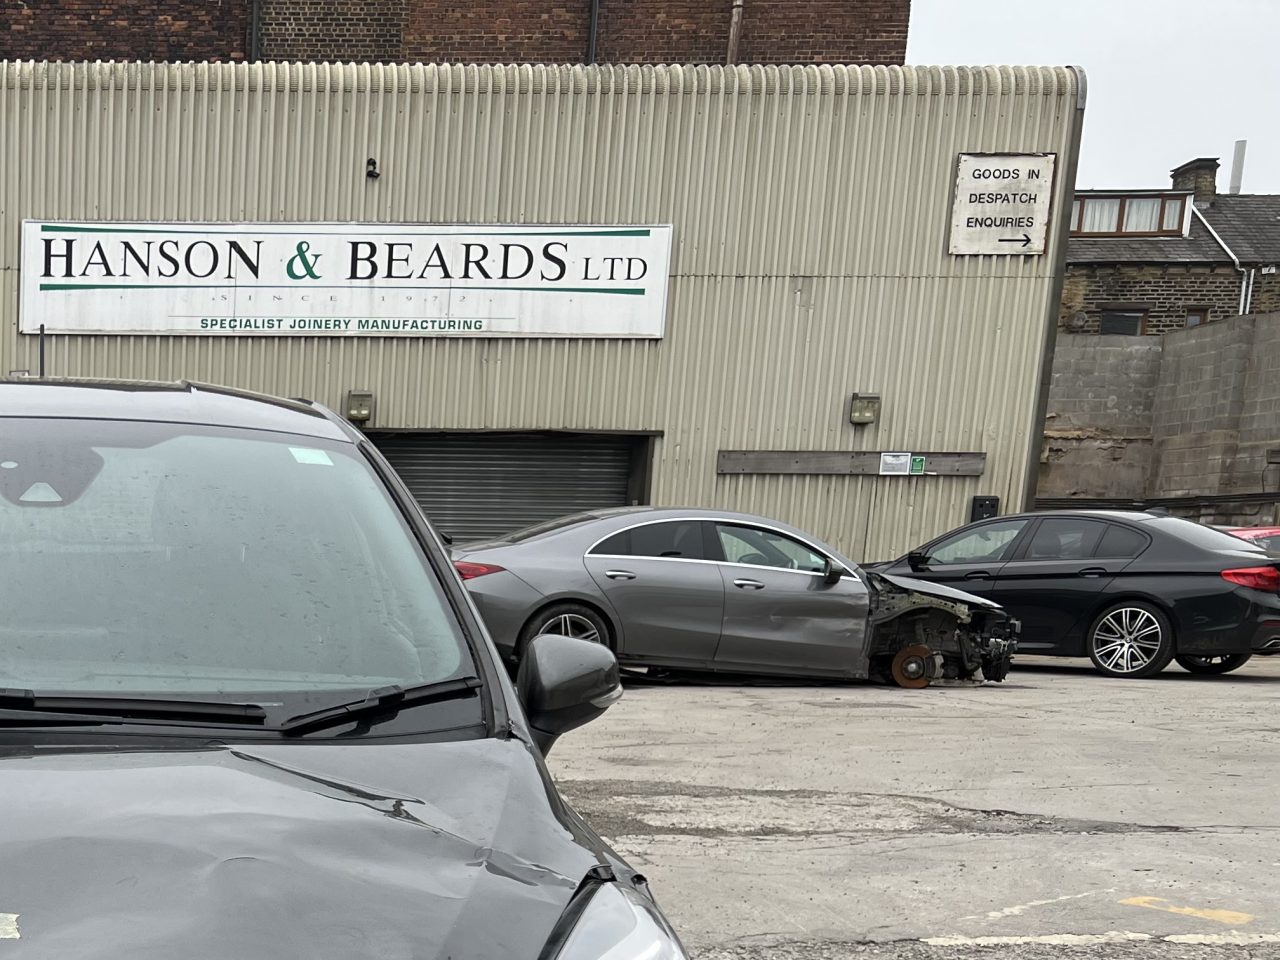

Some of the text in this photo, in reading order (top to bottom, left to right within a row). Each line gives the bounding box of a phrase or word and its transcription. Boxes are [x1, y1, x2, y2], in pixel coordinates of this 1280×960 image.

[972, 168, 1041, 180] GOODS IN
[968, 192, 1038, 204] DESPATCH
[966, 216, 1034, 228] ENQUIRIES
[40, 237, 648, 282] HANSON & BEARDS LTD
[200, 317, 484, 331] SPECIALIST JOINERY MANUFACTURING
